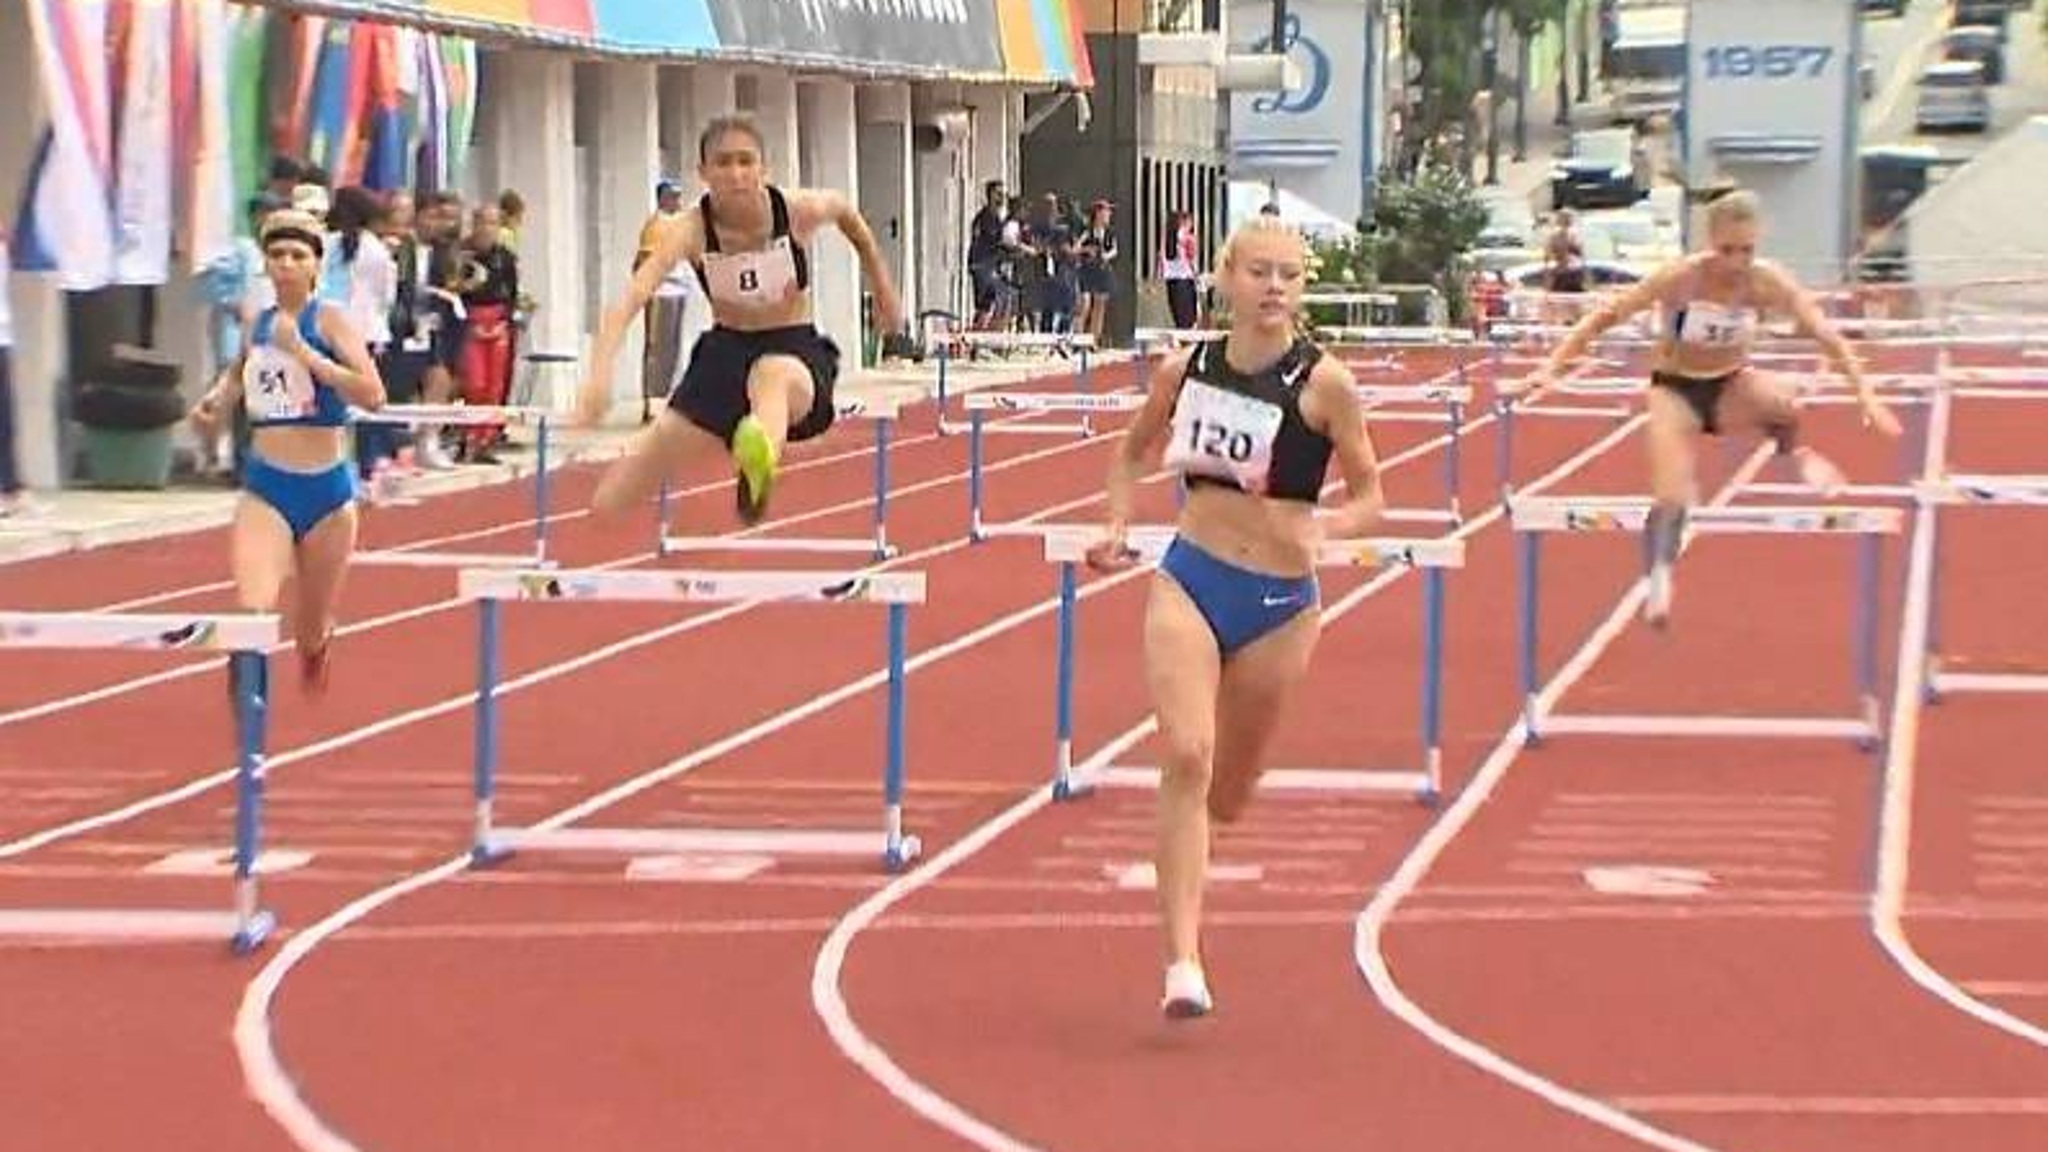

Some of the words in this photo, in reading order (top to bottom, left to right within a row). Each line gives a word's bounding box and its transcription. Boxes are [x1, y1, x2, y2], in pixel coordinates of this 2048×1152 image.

[739, 270, 759, 291] 8
[259, 369, 288, 395] 51
[1191, 419, 1253, 461] 120
